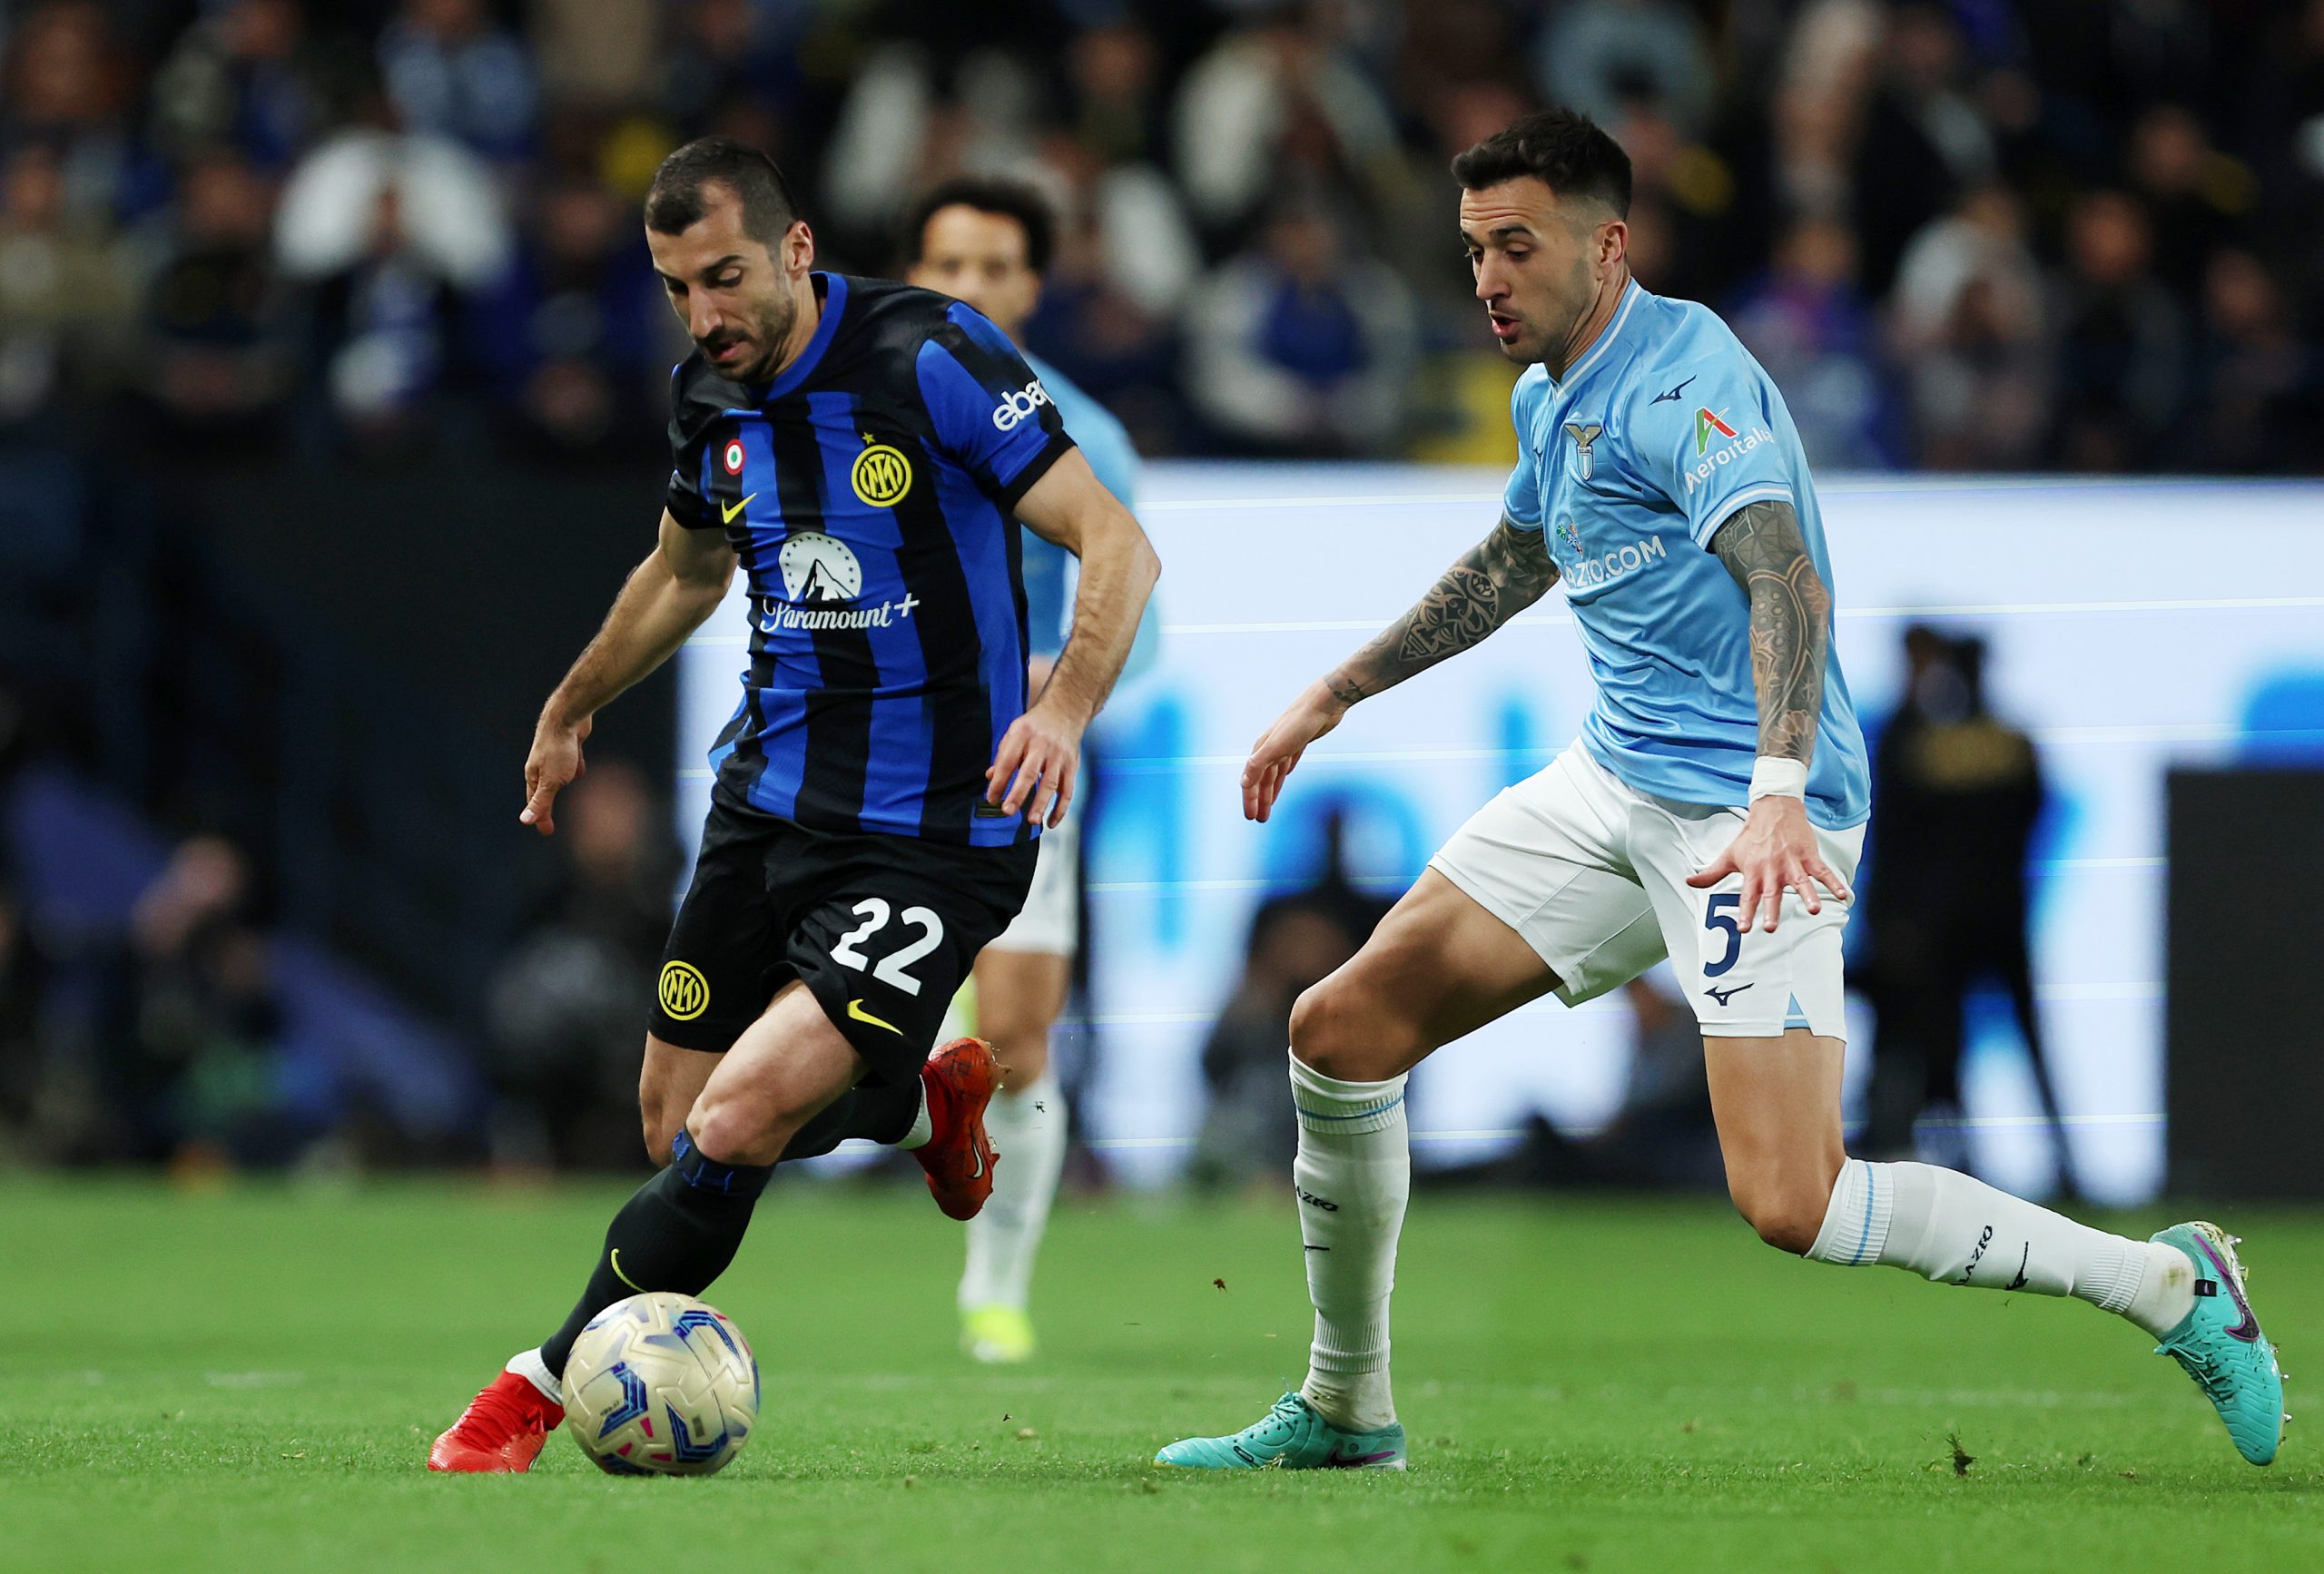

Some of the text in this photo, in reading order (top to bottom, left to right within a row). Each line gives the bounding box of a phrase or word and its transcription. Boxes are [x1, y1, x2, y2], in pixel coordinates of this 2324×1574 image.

[1565, 535, 1666, 588] AZIO.COM
[760, 593, 920, 633] Paramount+
[829, 897, 943, 997] 22
[1703, 893, 1742, 977] 5
